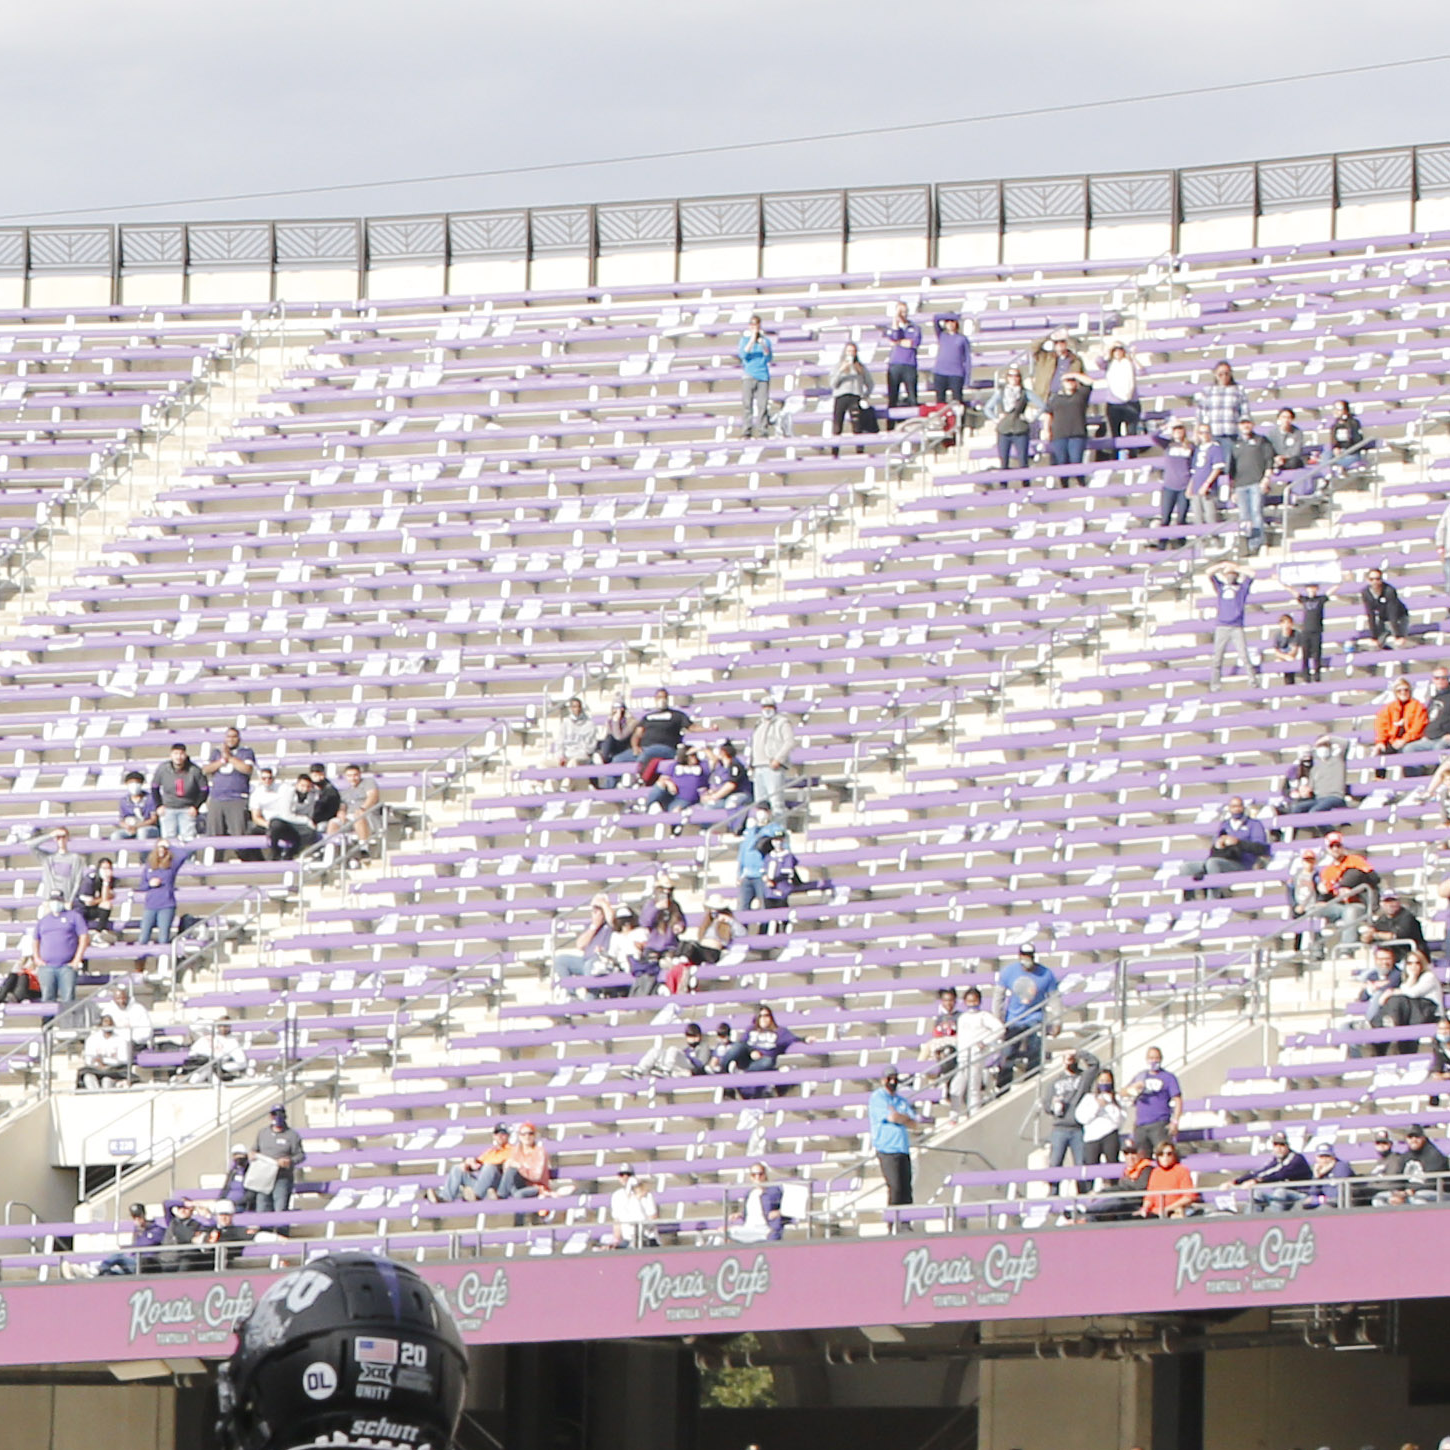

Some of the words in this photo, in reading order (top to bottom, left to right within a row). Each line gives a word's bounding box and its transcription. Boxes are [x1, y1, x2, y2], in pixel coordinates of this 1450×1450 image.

[903, 1247, 976, 1306] Rosa's
[984, 1239, 1038, 1294] Café
[1175, 1231, 1250, 1293] Rosa's
[1259, 1222, 1316, 1279] Café
[457, 1268, 508, 1318] Café
[637, 1262, 708, 1319] Rosa's
[716, 1254, 770, 1308] Café
[128, 1287, 197, 1343] Rosa's
[401, 1342, 427, 1368] 20
[307, 1372, 334, 1391] DL
[355, 1384, 391, 1400] UNITY
[350, 1417, 420, 1442] schutt
